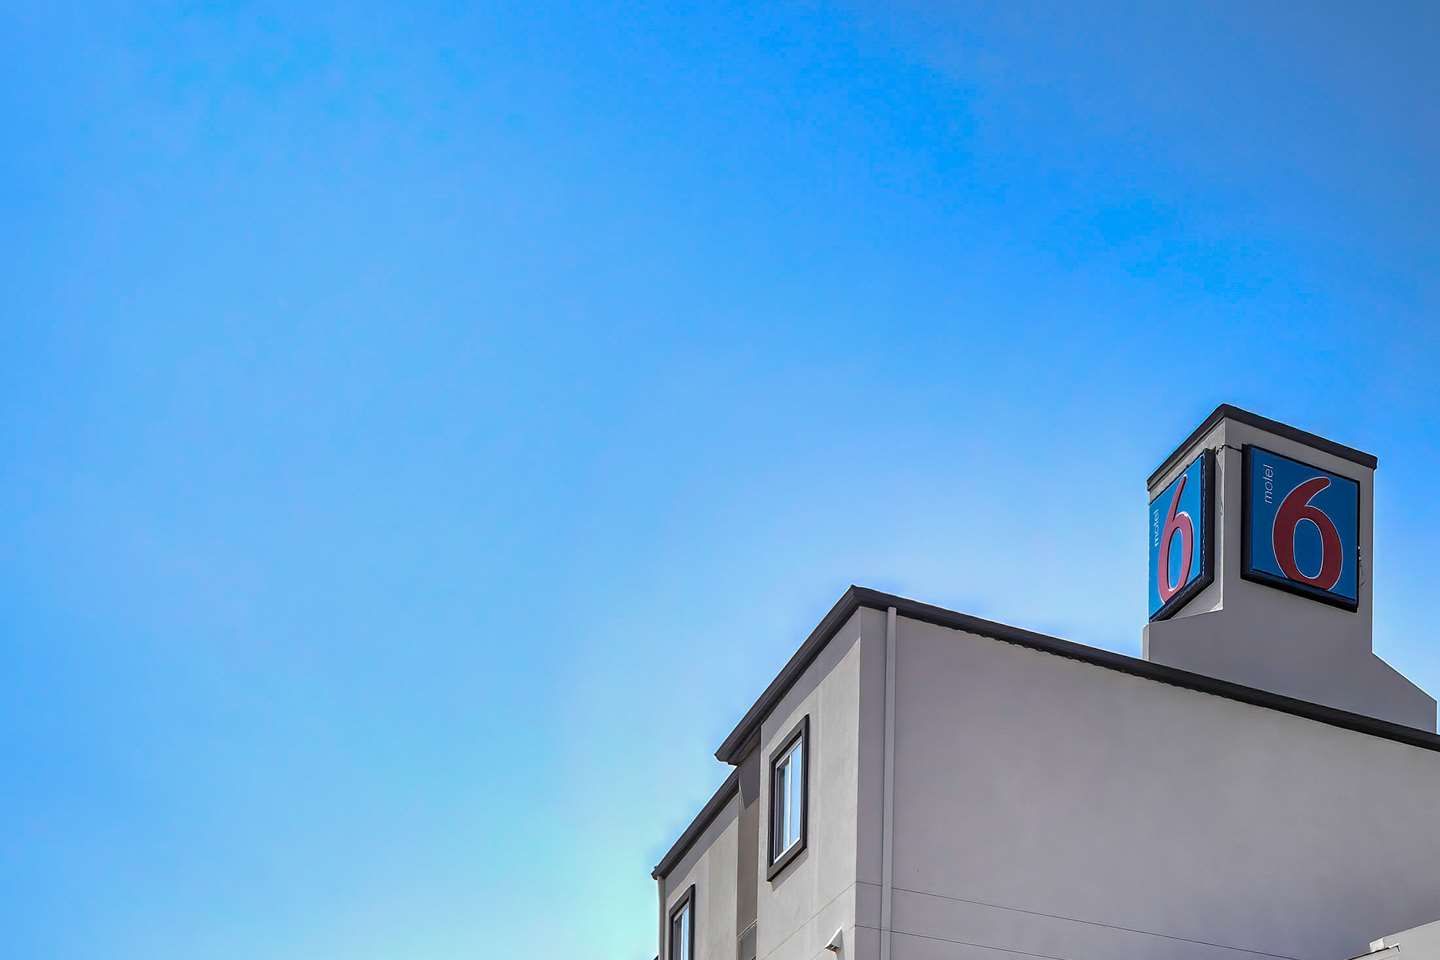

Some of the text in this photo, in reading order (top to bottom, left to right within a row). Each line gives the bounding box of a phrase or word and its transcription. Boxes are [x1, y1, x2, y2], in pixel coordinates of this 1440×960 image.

[1158, 474, 1194, 605] 6
[1264, 464, 1344, 591] motel 6
